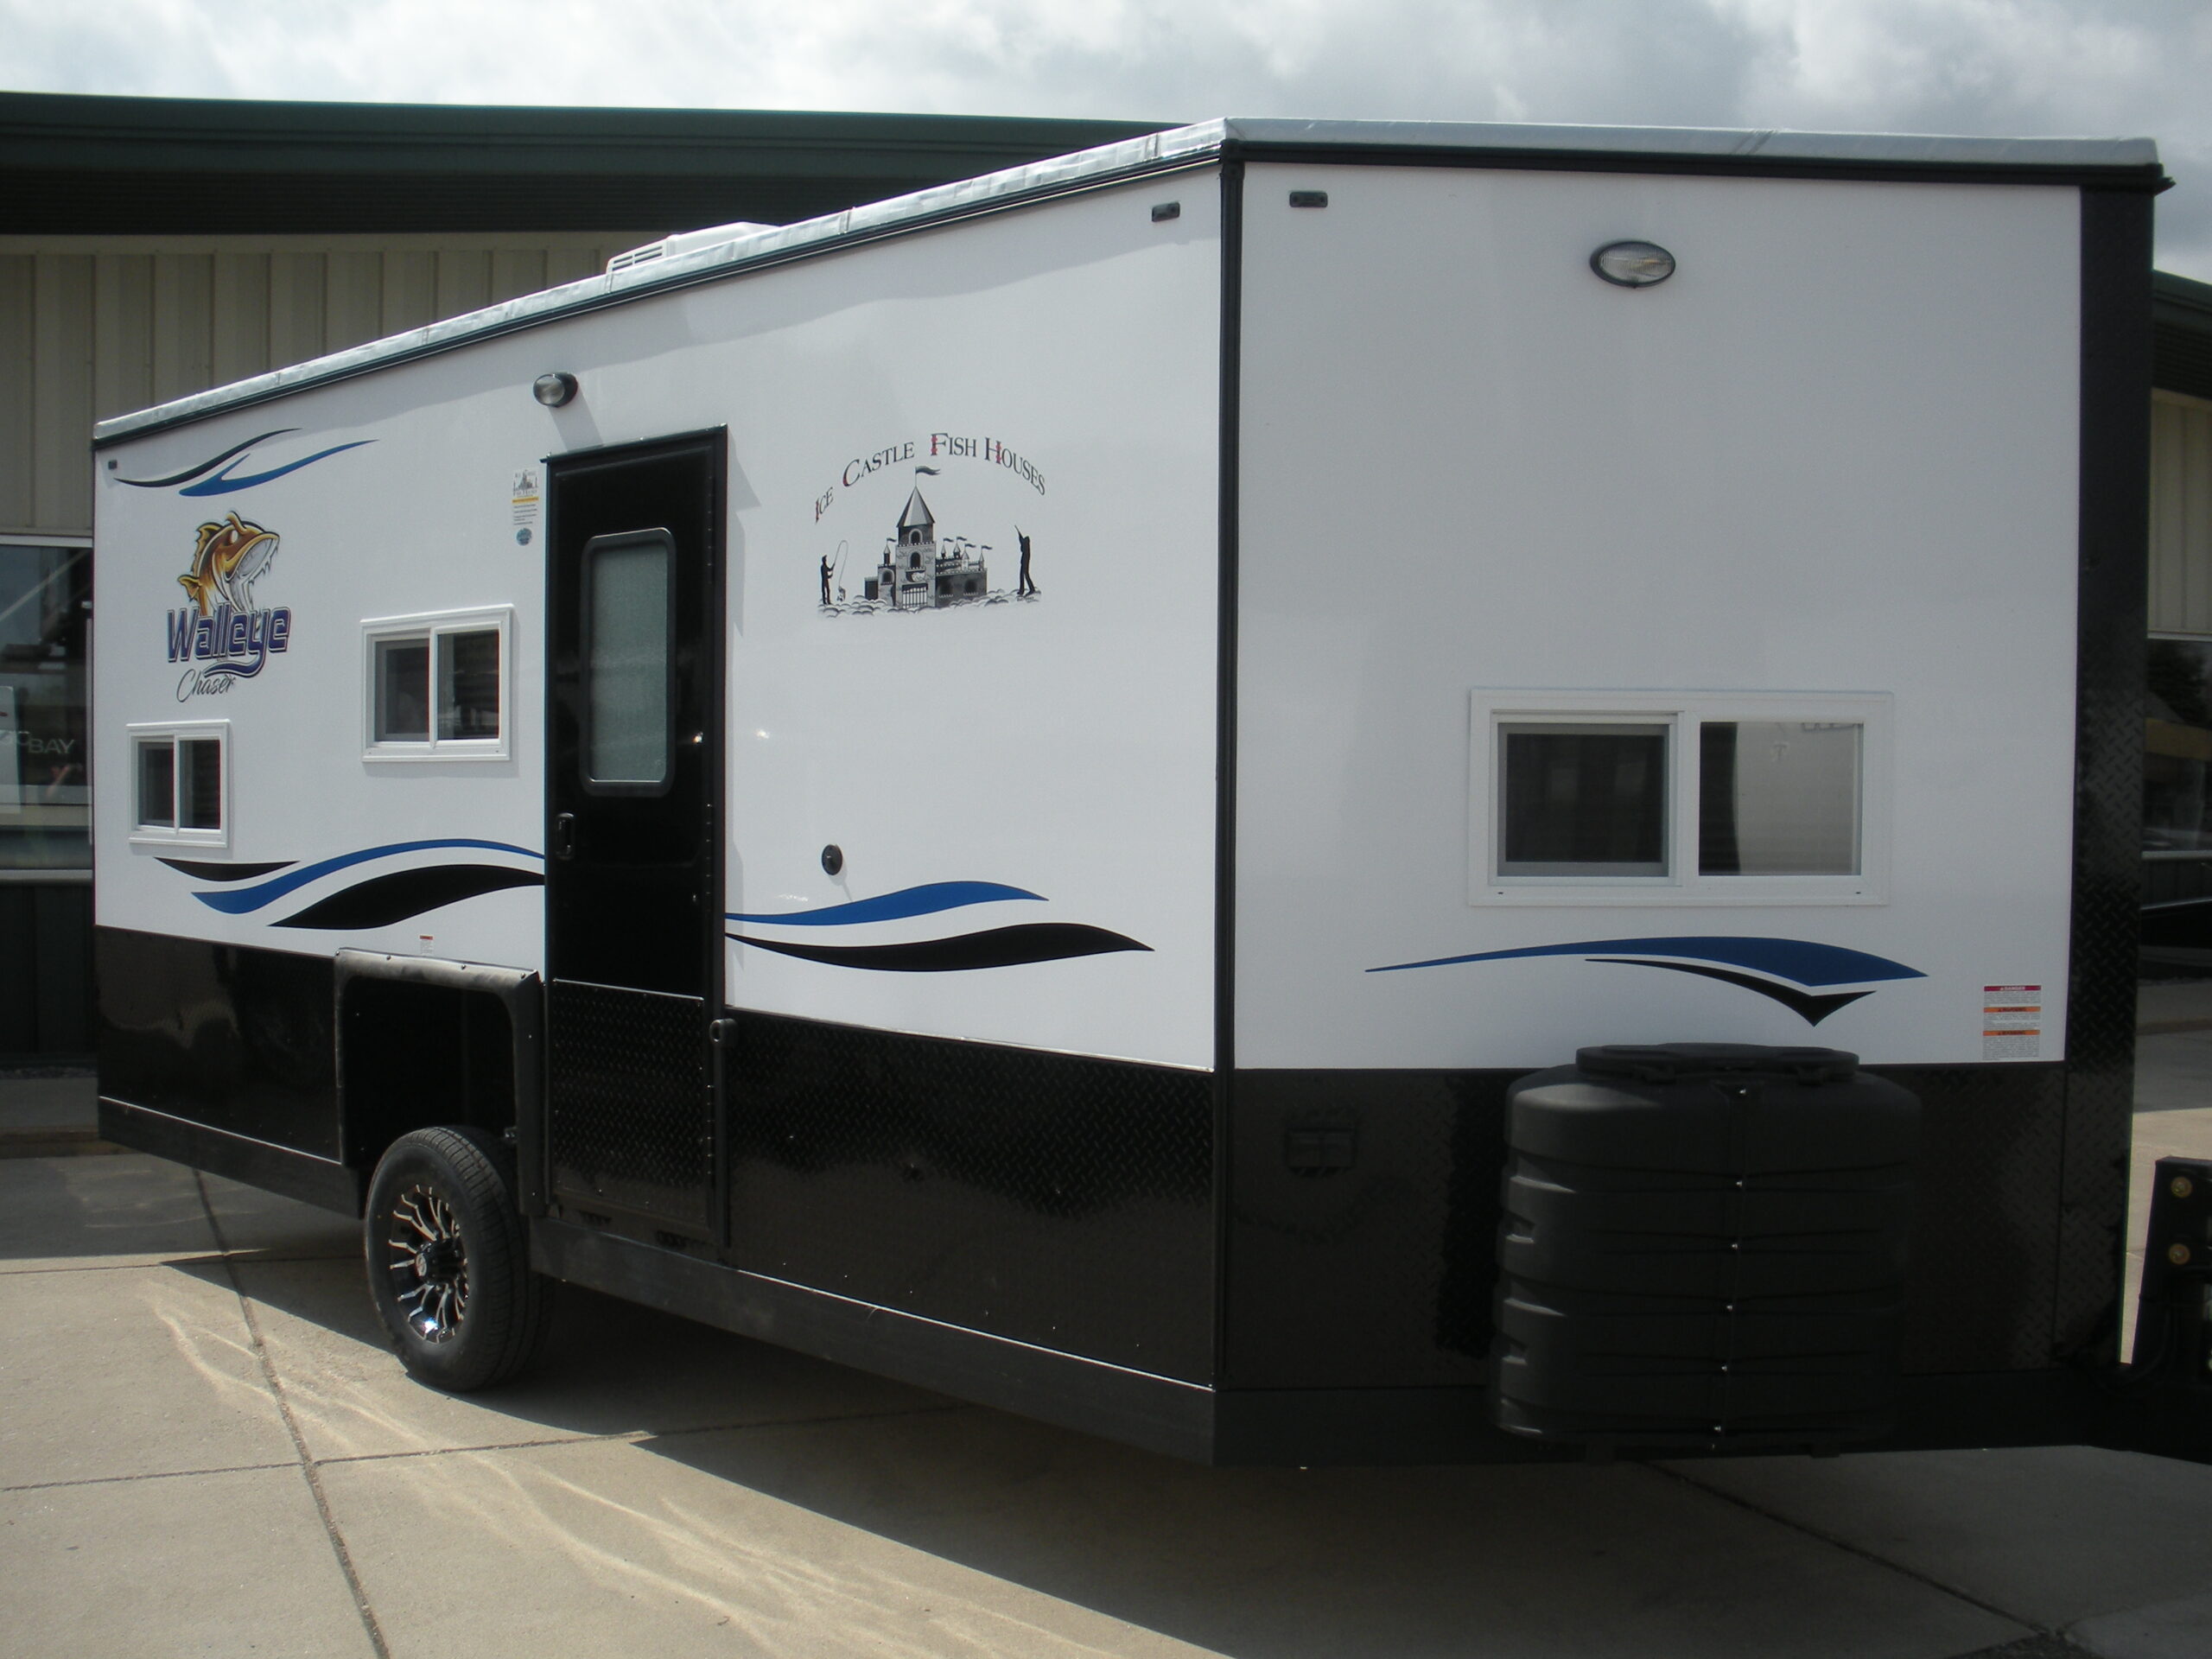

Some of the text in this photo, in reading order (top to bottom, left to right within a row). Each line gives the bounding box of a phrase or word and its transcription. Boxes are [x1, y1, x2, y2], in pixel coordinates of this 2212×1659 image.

[815, 432, 1046, 524] ICE CASTLE FISH HOUSES
[167, 602, 292, 678] Walleye
[176, 669, 236, 702] Chaser
